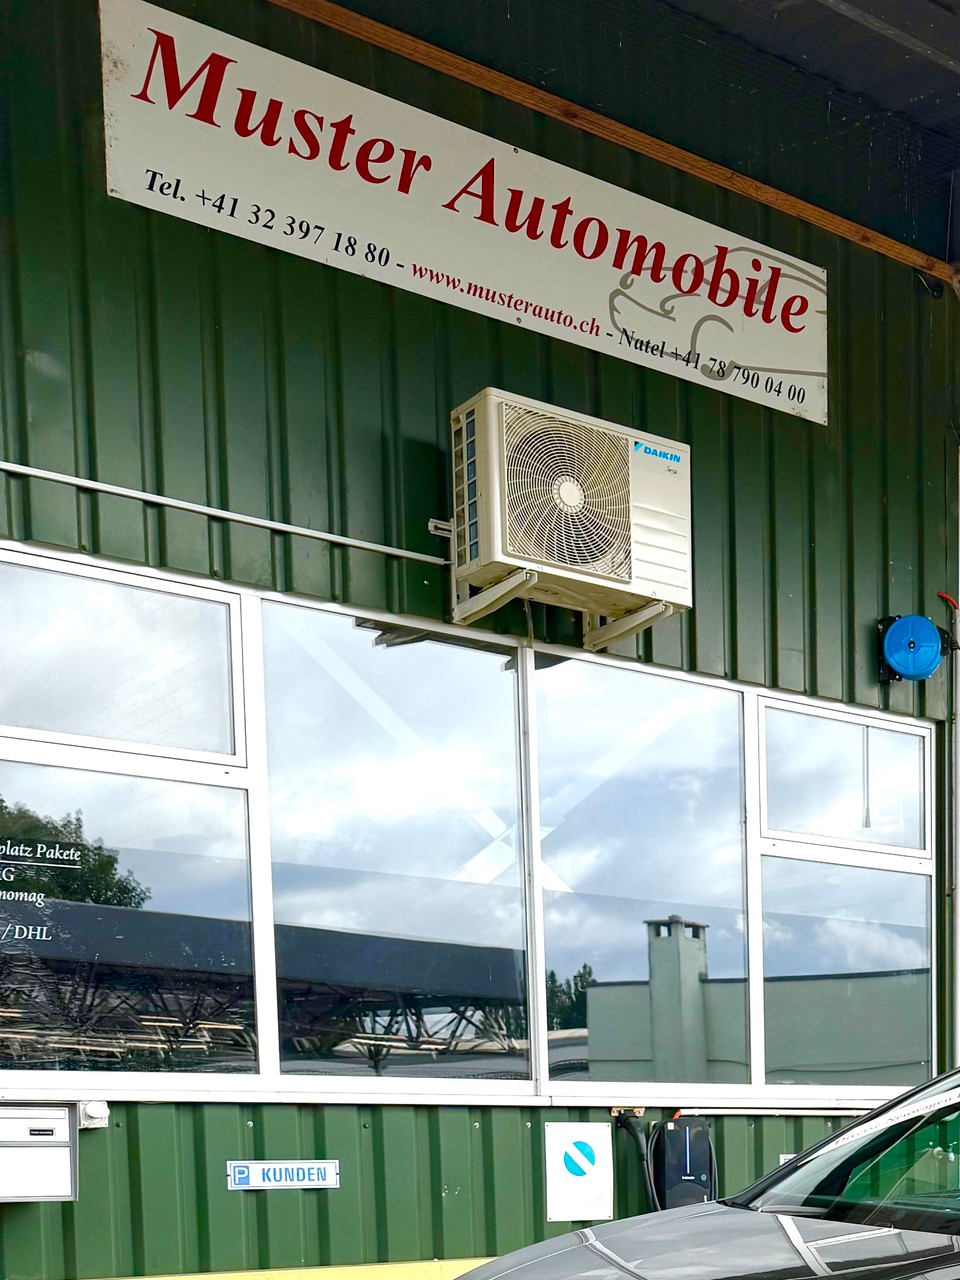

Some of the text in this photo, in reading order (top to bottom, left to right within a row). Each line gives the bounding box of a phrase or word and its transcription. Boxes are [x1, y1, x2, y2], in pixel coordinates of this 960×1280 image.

[132, 27, 809, 334] Muster Automobile
[145, 168, 186, 202] Tel.
[195, 188, 240, 219] +41
[247, 204, 276, 230] 32
[283, 215, 326, 245] 397
[331, 231, 358, 257] 18
[364, 242, 390, 267] 80
[411, 263, 601, 337] www.musterauto.ch
[618, 327, 666, 359] Natel
[670, 346, 701, 371] +41
[708, 357, 727, 379] 78
[732, 366, 760, 390] 790
[764, 376, 783, 398] 04
[787, 384, 807, 405] 00
[644, 446, 681, 463] DAIKIN
[36, 843, 81, 861] Pakete
[0, 867, 15, 882] G
[14, 925, 52, 940] DHL
[262, 1167, 327, 1182] KUNDEN
